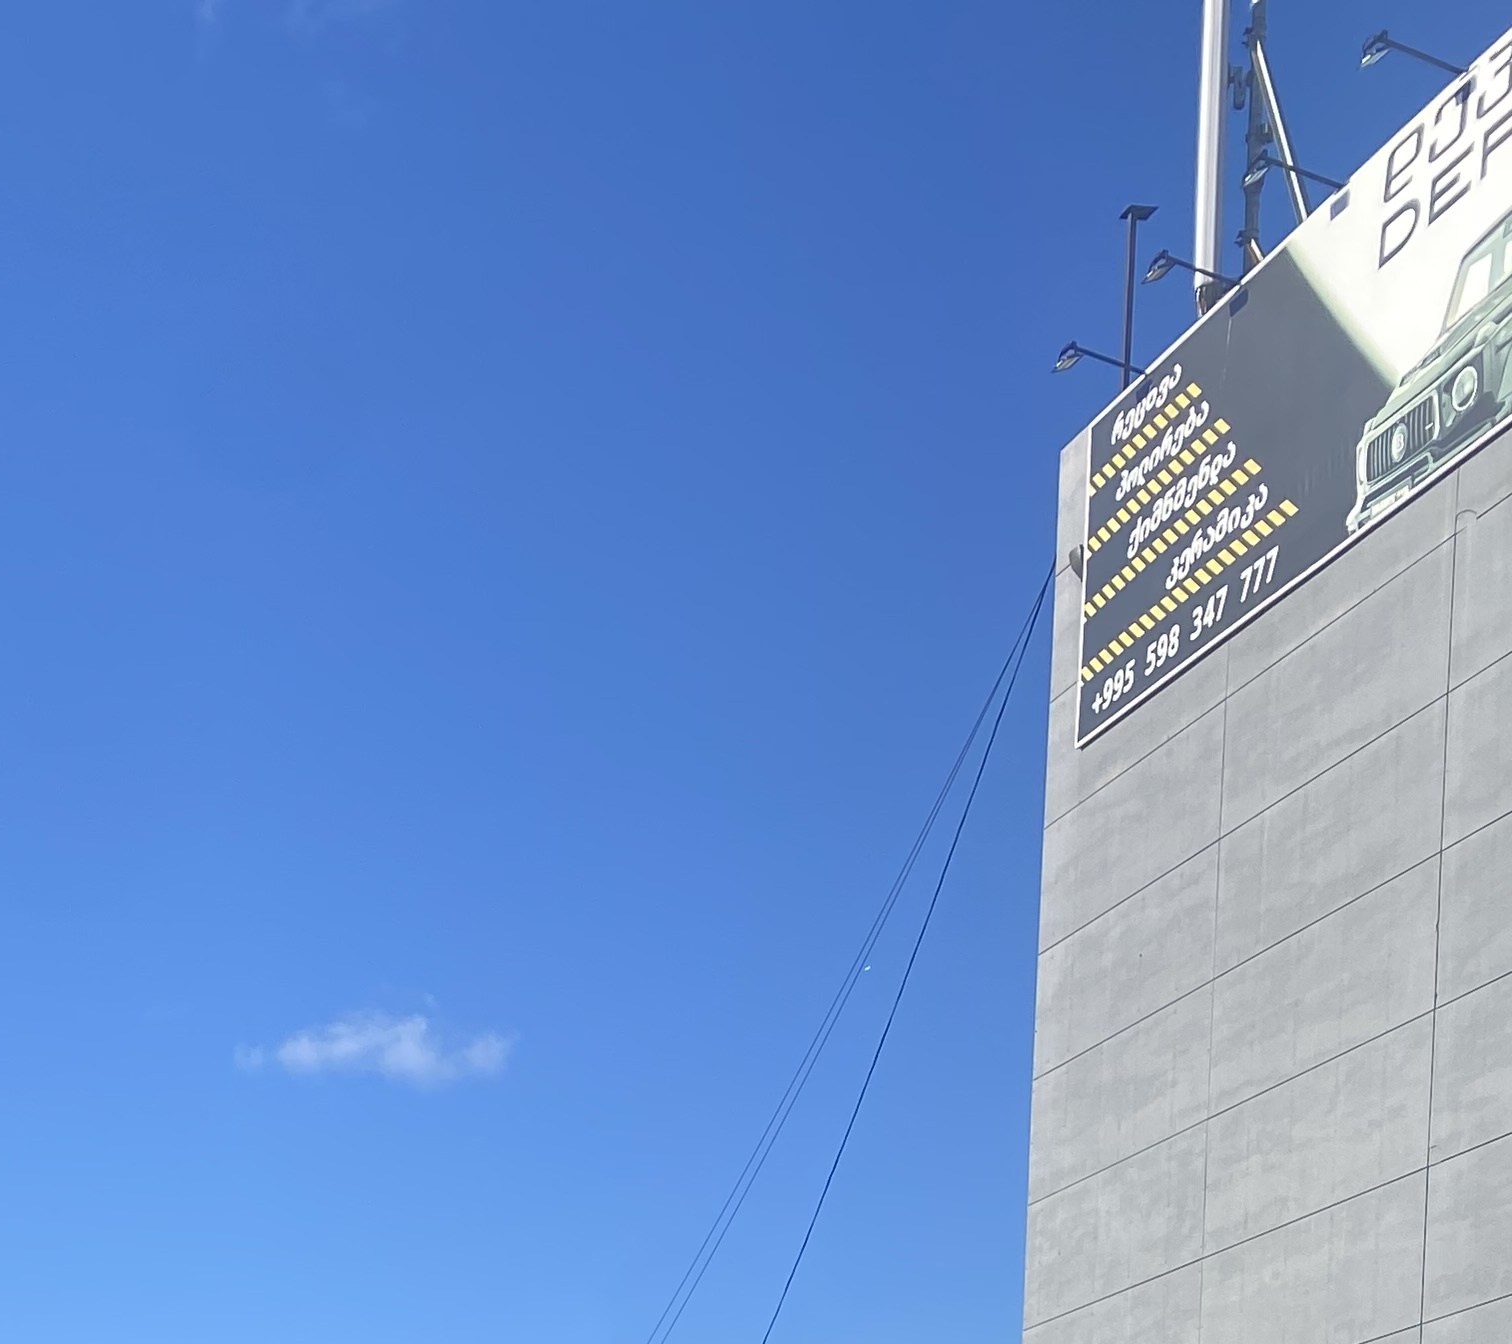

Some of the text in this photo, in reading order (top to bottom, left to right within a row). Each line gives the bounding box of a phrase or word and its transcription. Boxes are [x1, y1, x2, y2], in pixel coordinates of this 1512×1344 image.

[1115, 400, 1210, 501] პოლირება
[1127, 441, 1237, 559] ქიმწმენდა
[1165, 483, 1269, 590] კერამიკა
[1091, 546, 1280, 714] +995 598 347 777
